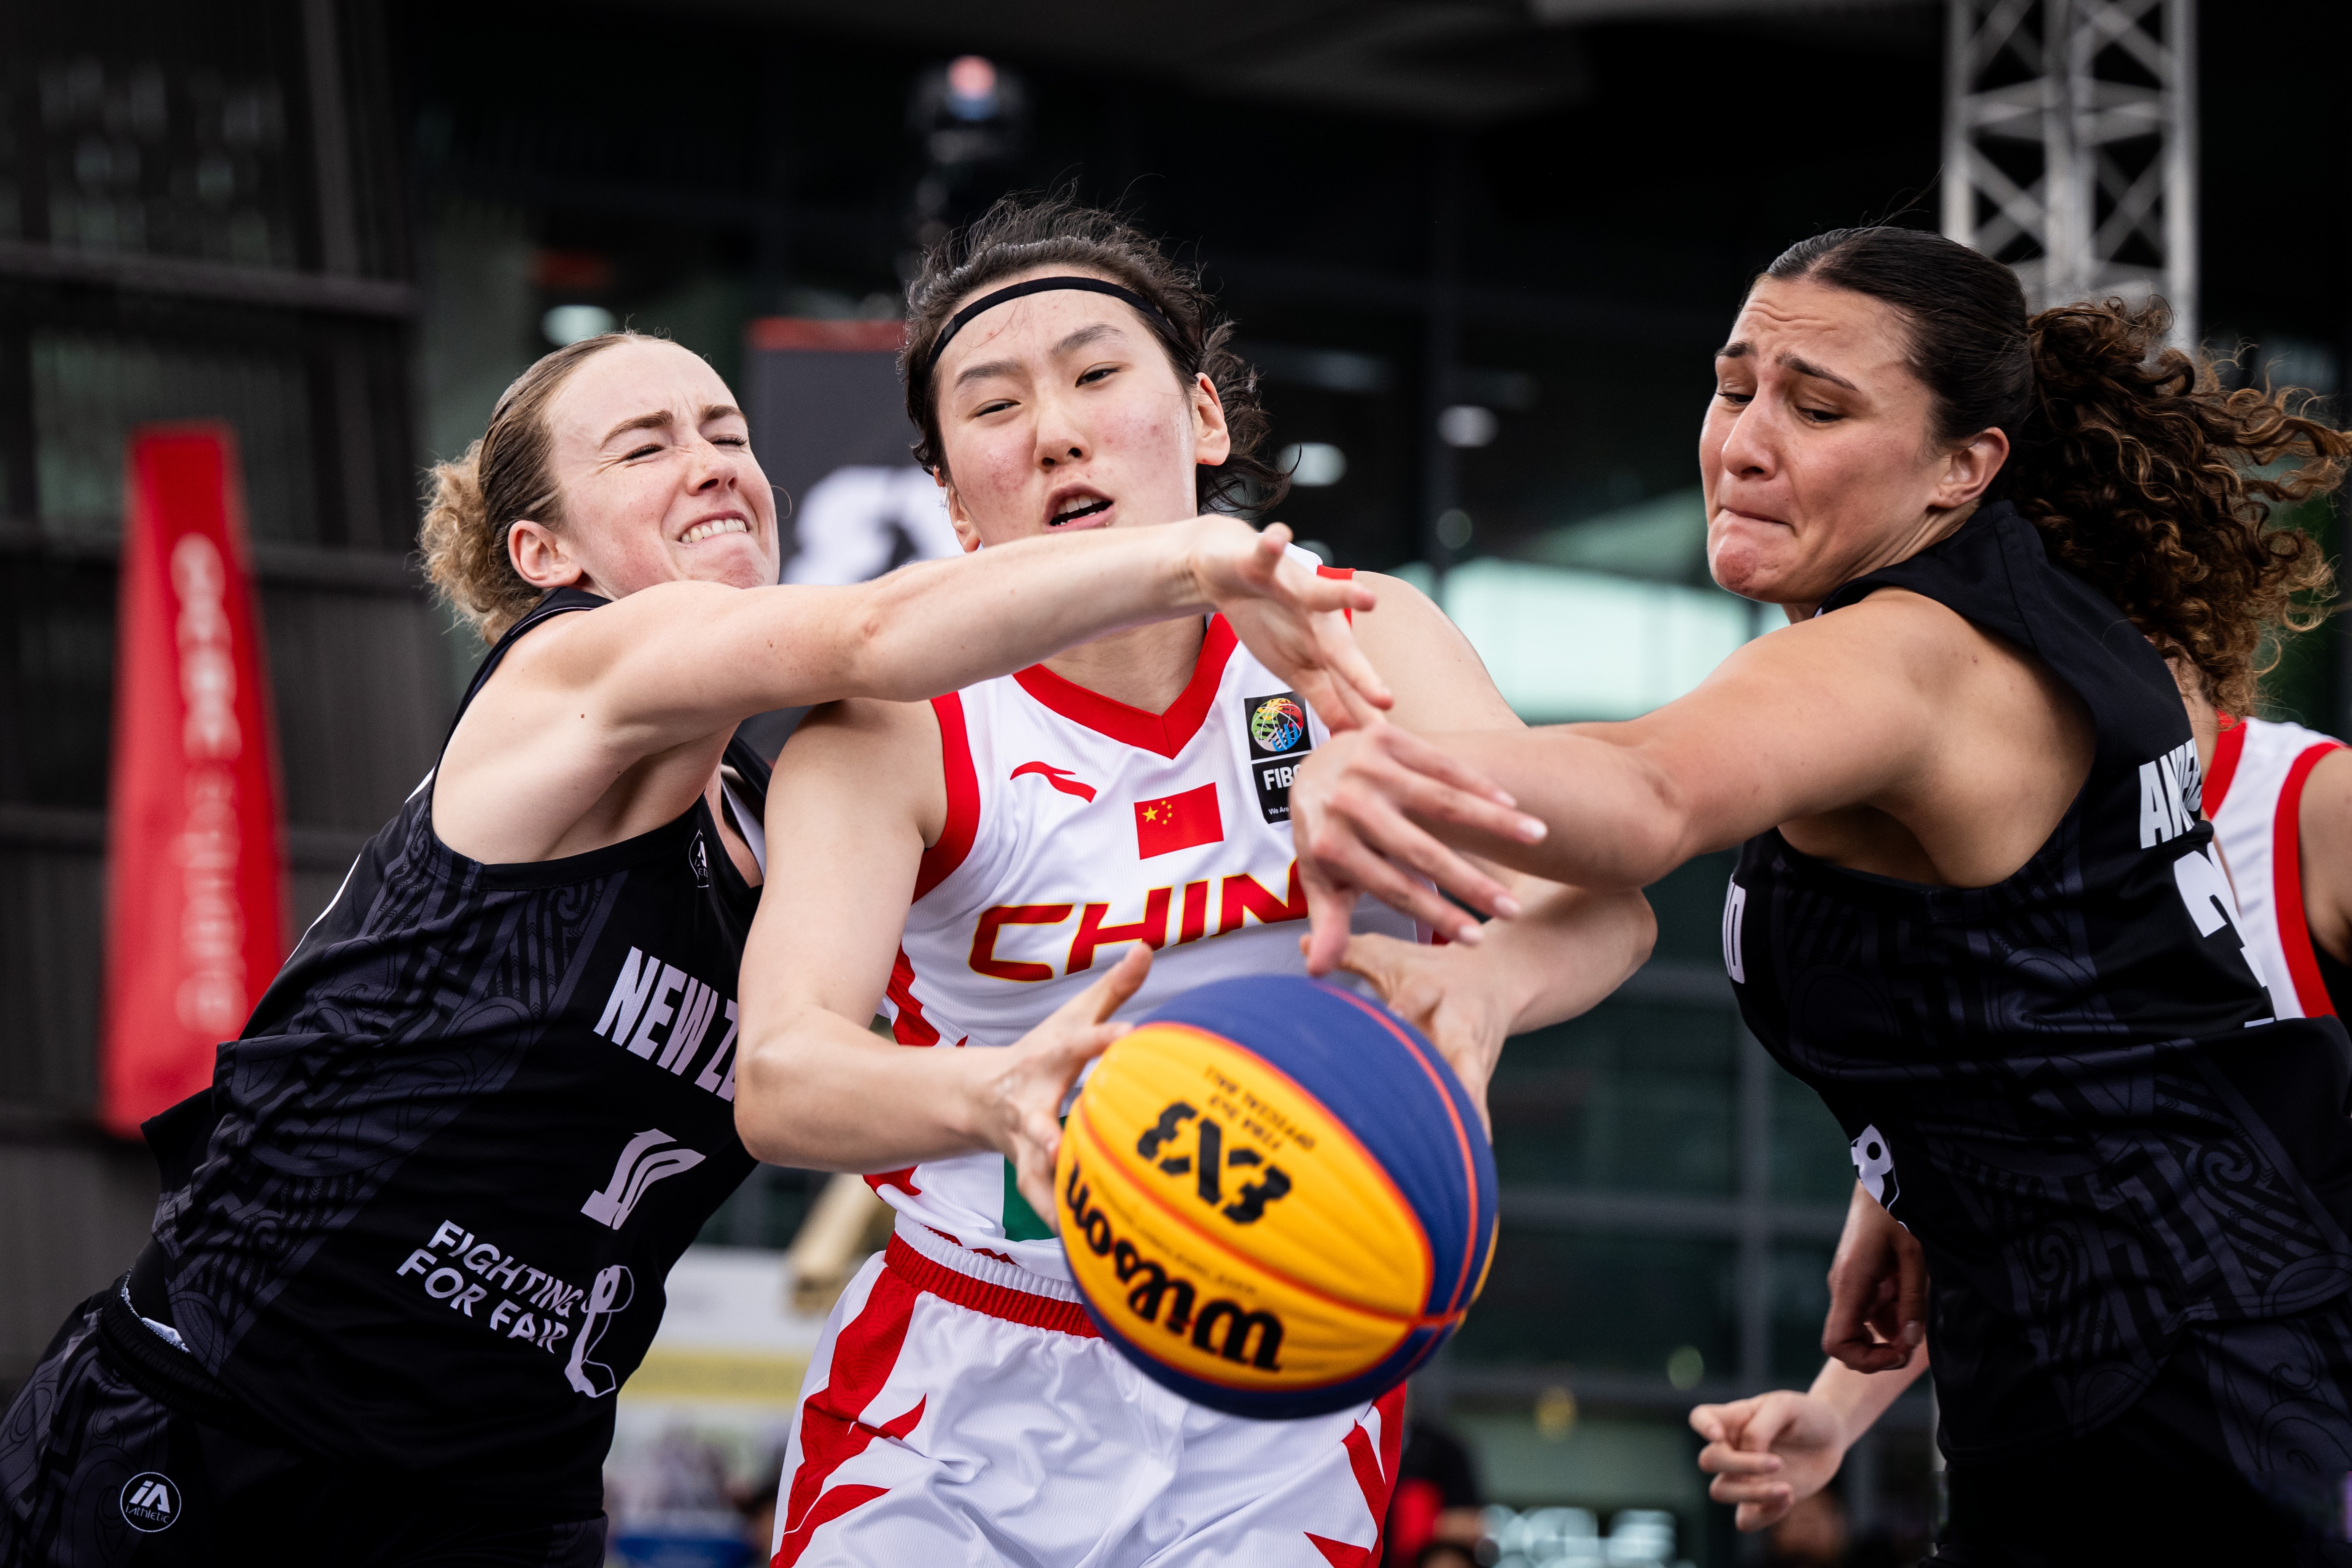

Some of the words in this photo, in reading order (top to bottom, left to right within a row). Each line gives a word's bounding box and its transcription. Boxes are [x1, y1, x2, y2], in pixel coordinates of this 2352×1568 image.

[1722, 874, 1746, 984] D
[593, 946, 718, 1076] NEW
[396, 1248, 487, 1318] FOR
[490, 1299, 568, 1354] FAIR
[428, 1220, 584, 1318] FIGHTING
[1063, 1157, 1284, 1373] Wilson
